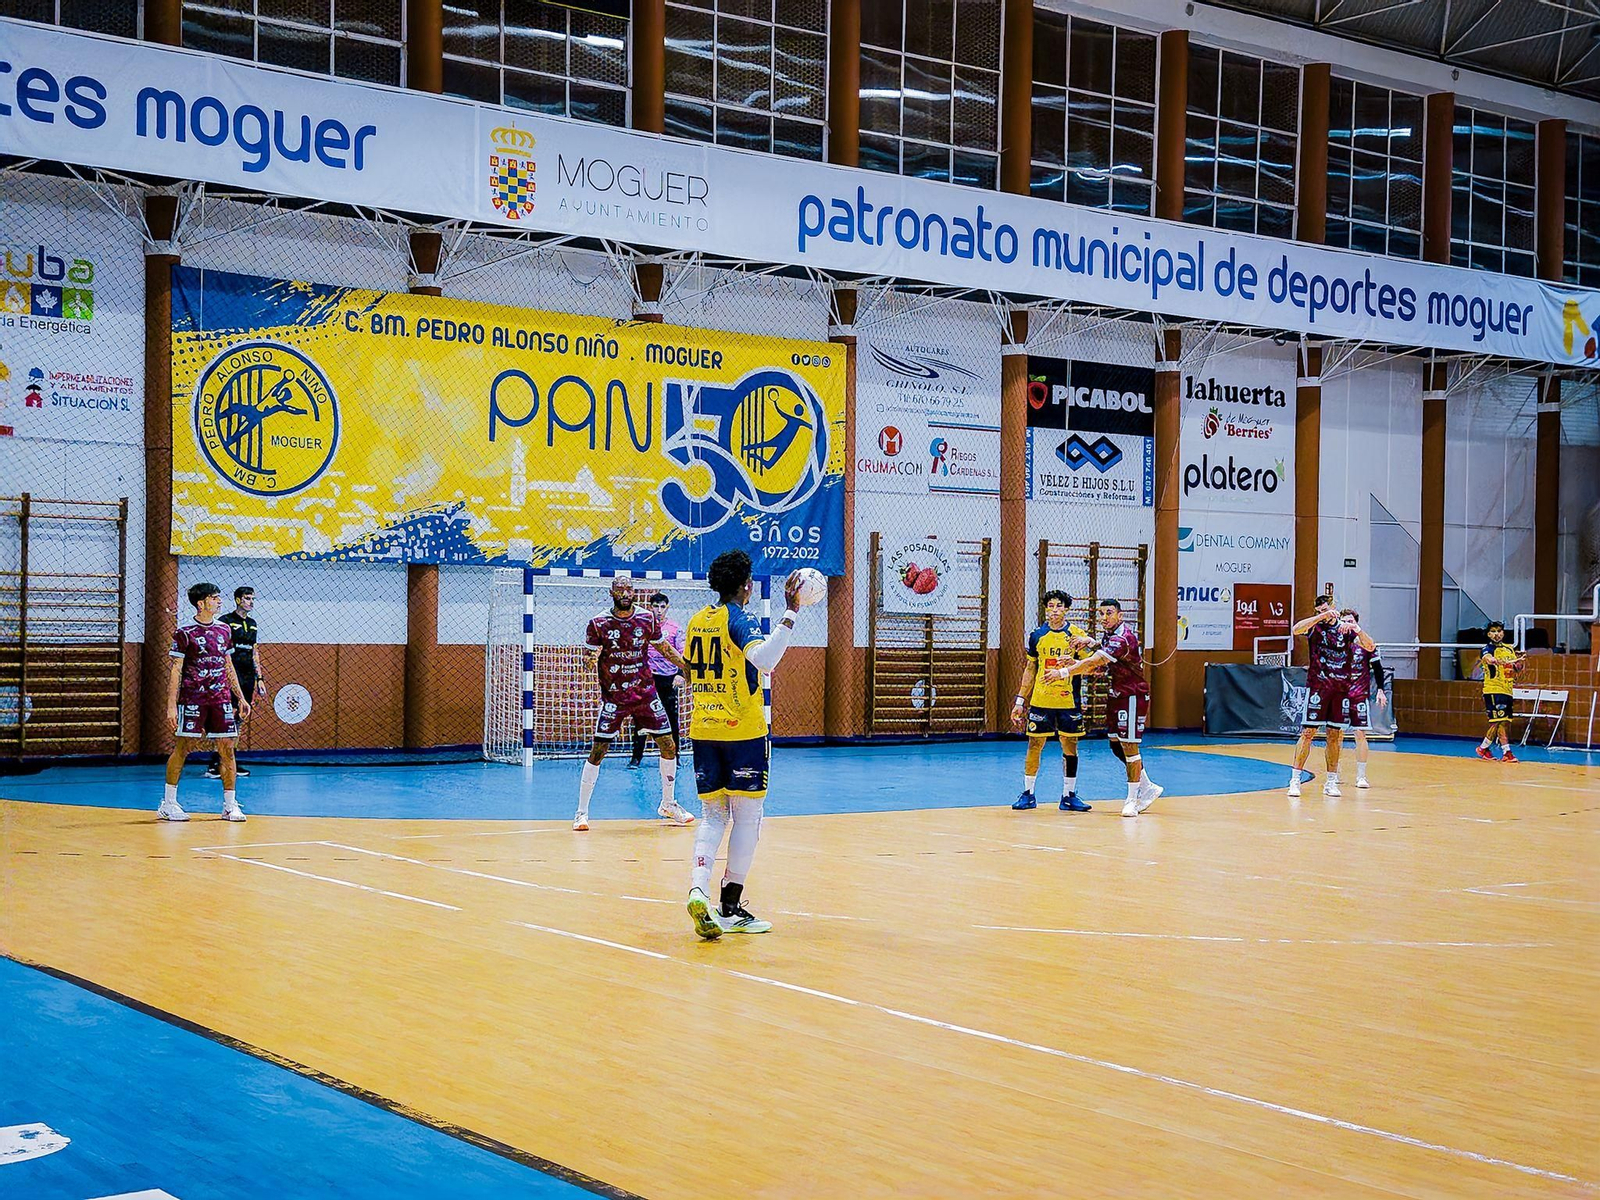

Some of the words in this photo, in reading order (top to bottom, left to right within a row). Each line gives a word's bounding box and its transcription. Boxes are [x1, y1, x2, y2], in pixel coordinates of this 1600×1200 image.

[136, 87, 377, 173] moguer
[556, 153, 709, 208] MOGUER
[559, 198, 709, 232] AYUNTAMIENTO
[0, 245, 94, 284] uba
[798, 185, 1018, 264] patronato
[1032, 227, 1204, 300] municipal
[1214, 247, 1258, 300] de
[1268, 255, 1416, 323] deportes
[1428, 291, 1534, 342] moguer
[20, 316, 91, 335] Energética
[345, 310, 364, 332] C.
[371, 313, 410, 338] BM.
[416, 318, 485, 345] PEDRO
[492, 327, 569, 355] ALONSO
[575, 334, 619, 361] NIÑO
[645, 344, 723, 370] MOGUER
[203, 393, 220, 450] PEDRO
[216, 351, 273, 383] ALONSO
[1052, 384, 1153, 414] PICABOL
[1185, 375, 1286, 408] lahuerta
[489, 369, 653, 453] PAN
[271, 435, 322, 449] MOGUER
[1040, 472, 1070, 488] VÉLEZ
[1073, 477, 1079, 488] E
[1082, 477, 1110, 490] HIJOS
[1184, 454, 1278, 497] platero
[1104, 492, 1136, 501] Reformas
[749, 520, 821, 543] años
[1196, 533, 1235, 548] DENTAL
[1238, 535, 1291, 550] COMPANY
[762, 546, 820, 559] 1972-2022
[887, 550, 903, 570] LAS
[903, 543, 952, 573] POSADILLAS
[1216, 562, 1251, 573] MOGUER
[1236, 600, 1258, 615] 1941
[608, 630, 620, 639] 28
[690, 635, 724, 680] 44
